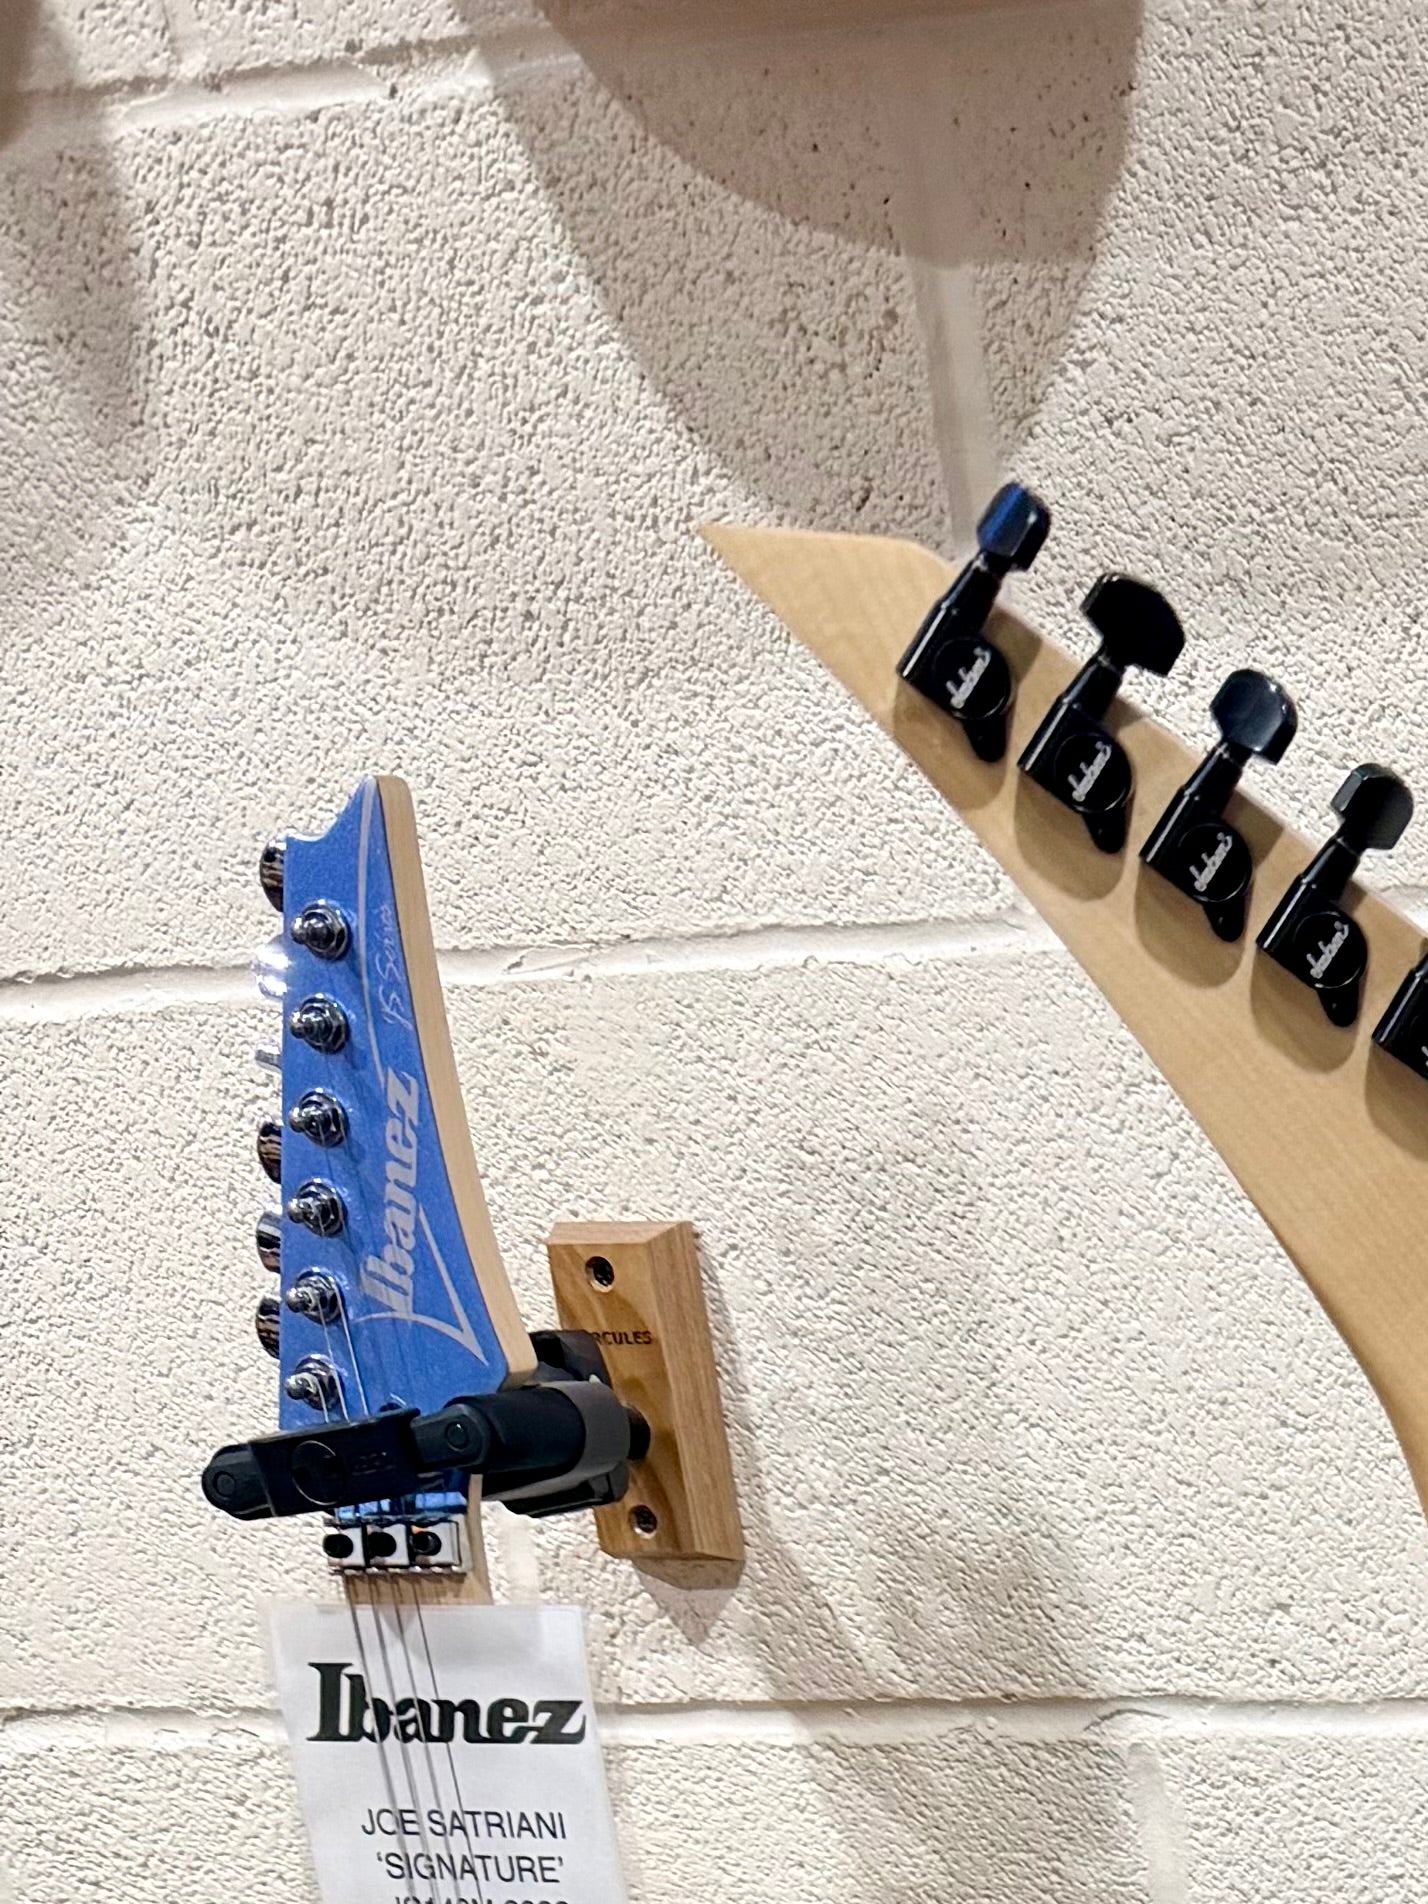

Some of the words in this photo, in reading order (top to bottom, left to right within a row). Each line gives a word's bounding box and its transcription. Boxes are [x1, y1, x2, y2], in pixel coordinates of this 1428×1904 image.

[359, 1066, 420, 1326] Ibanez
[306, 1662, 586, 1744] Ibanez
[361, 1808, 421, 1836] JOE
[427, 1810, 566, 1839] SATRIANI
